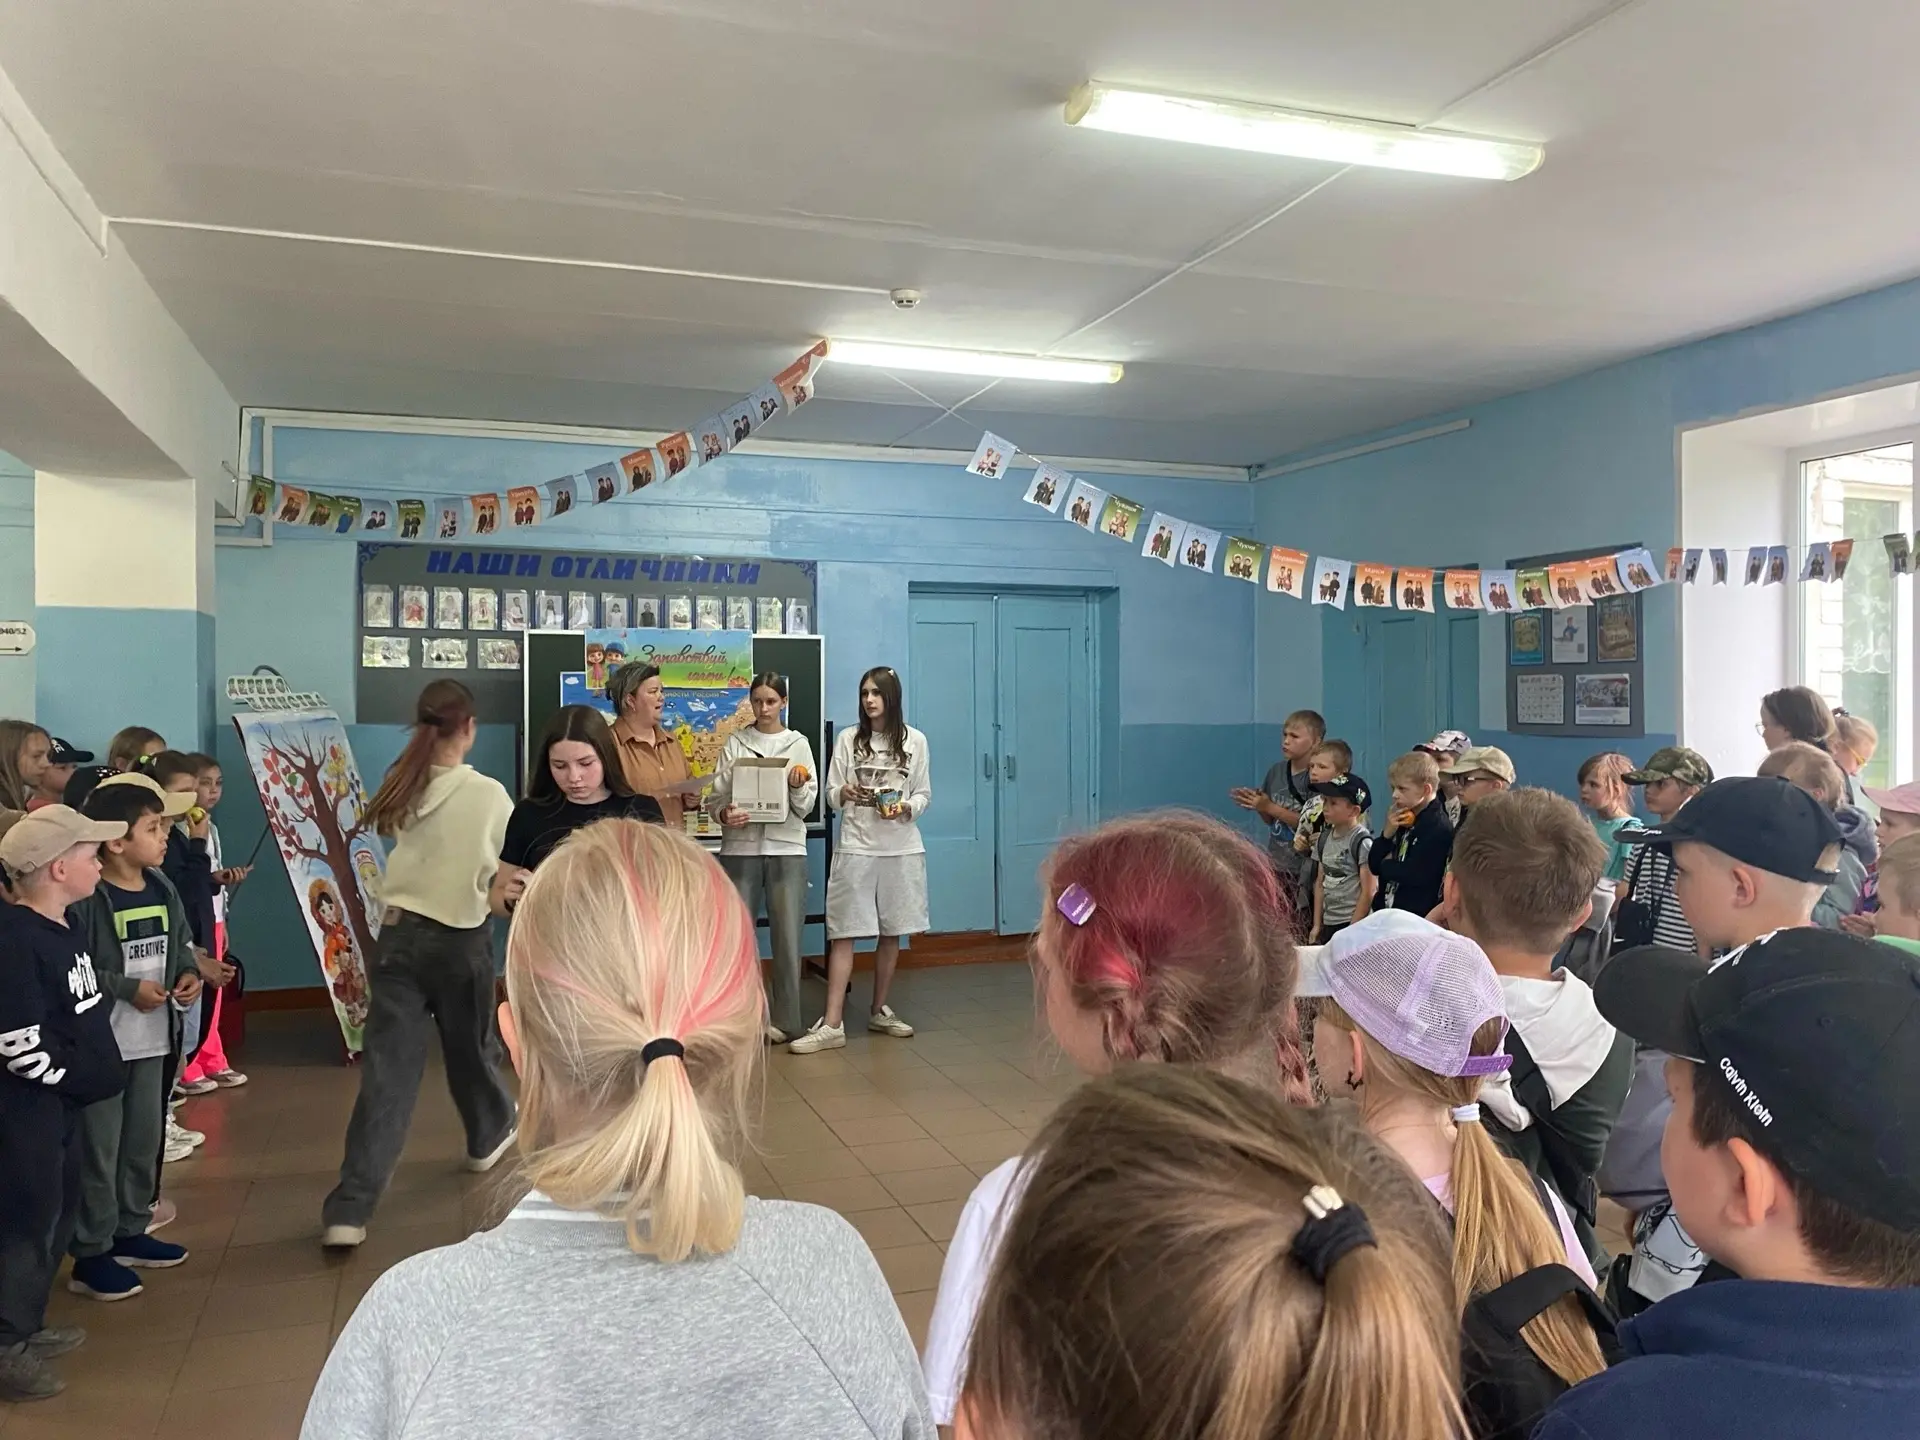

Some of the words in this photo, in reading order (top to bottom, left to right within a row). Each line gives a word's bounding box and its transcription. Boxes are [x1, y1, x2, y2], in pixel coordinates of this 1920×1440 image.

[427, 551, 542, 577] НАШИ
[551, 556, 760, 585] ОТЛИЧНИКИ
[228, 678, 286, 696] ДЕРЕВО
[129, 940, 165, 960] CREATIVE
[1720, 1057, 1748, 1097] Calvin
[1743, 1090, 1773, 1127] Klein
